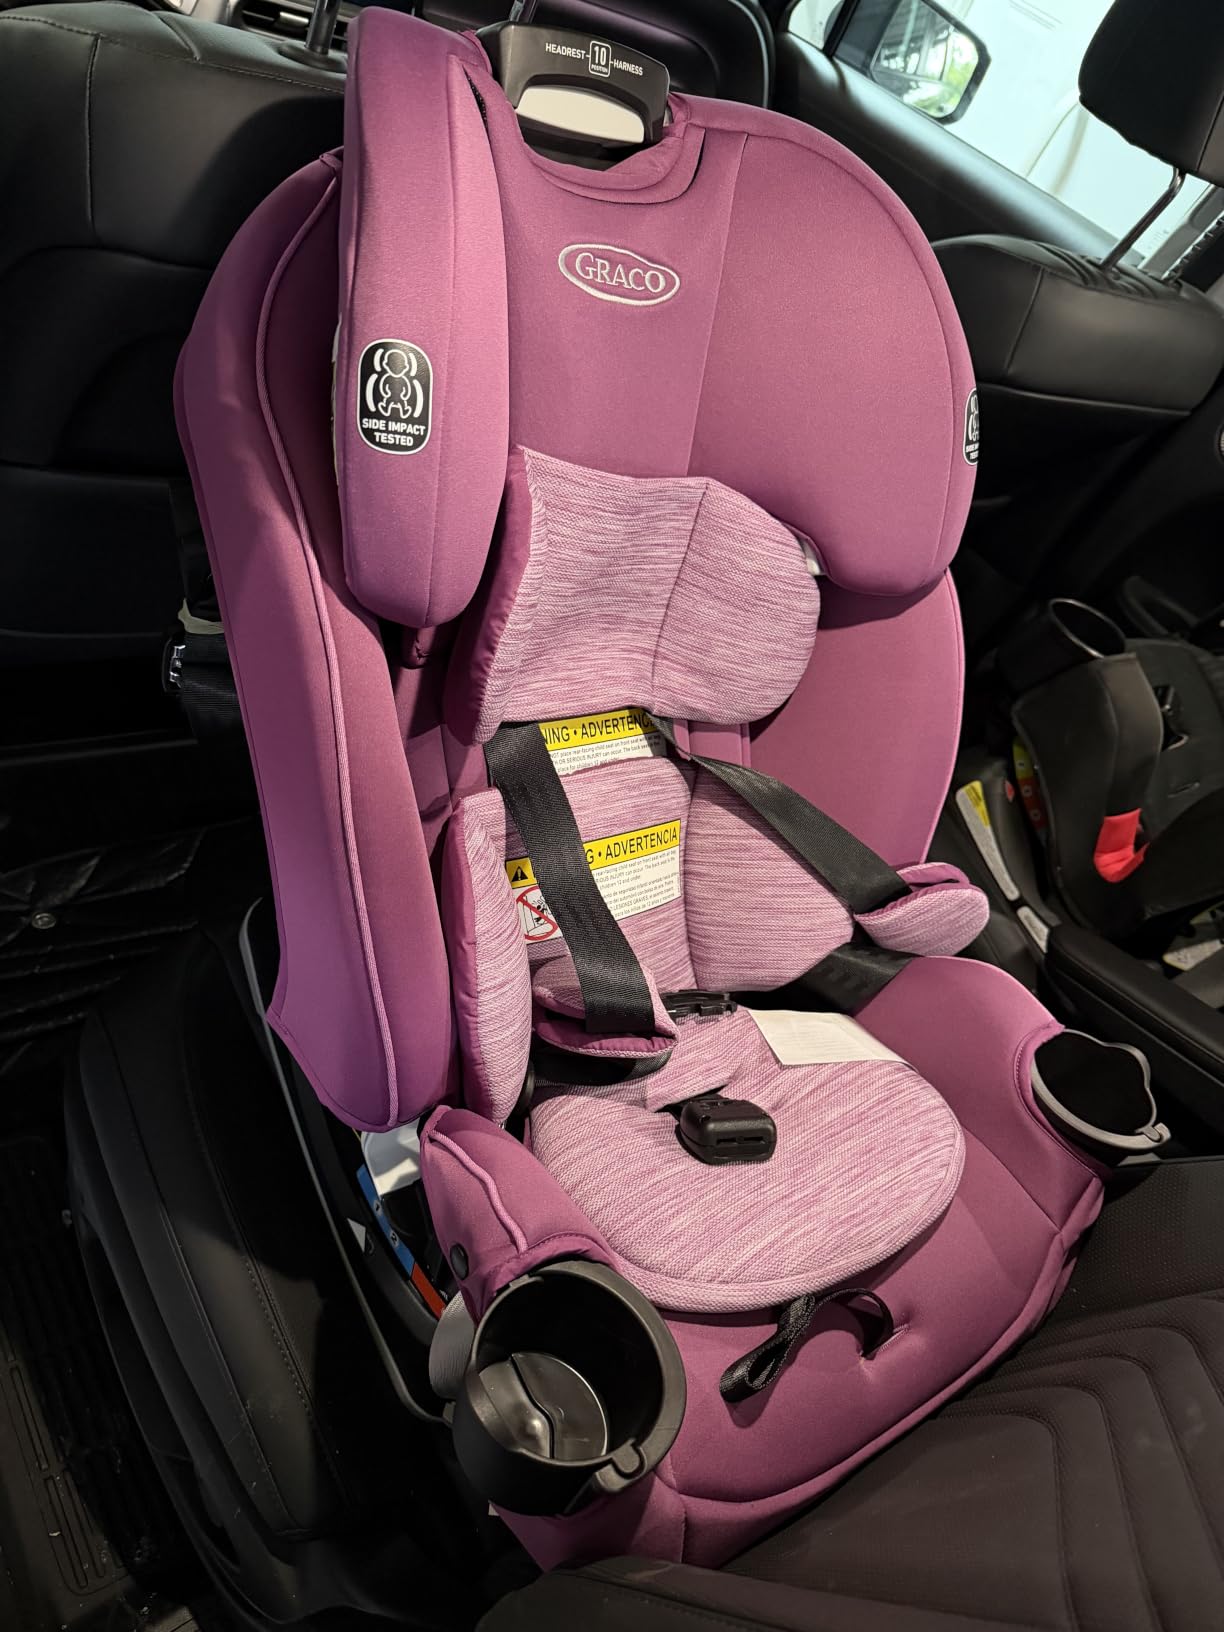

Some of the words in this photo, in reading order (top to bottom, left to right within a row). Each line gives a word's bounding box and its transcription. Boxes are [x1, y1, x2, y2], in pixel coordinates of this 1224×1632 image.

[545, 42, 585, 60] HEADREST
[594, 46, 607, 65] 10
[613, 59, 643, 76] HARNESS
[591, 64, 608, 73] POSITION
[575, 252, 666, 293] GRACO
[362, 418, 386, 430] SIDE
[388, 421, 425, 435] IMPACT
[374, 432, 413, 446] TESTED
[544, 726, 570, 745] NING
[581, 713, 653, 740] ADVERTENC
[605, 827, 678, 860] ADVERTENCIA
